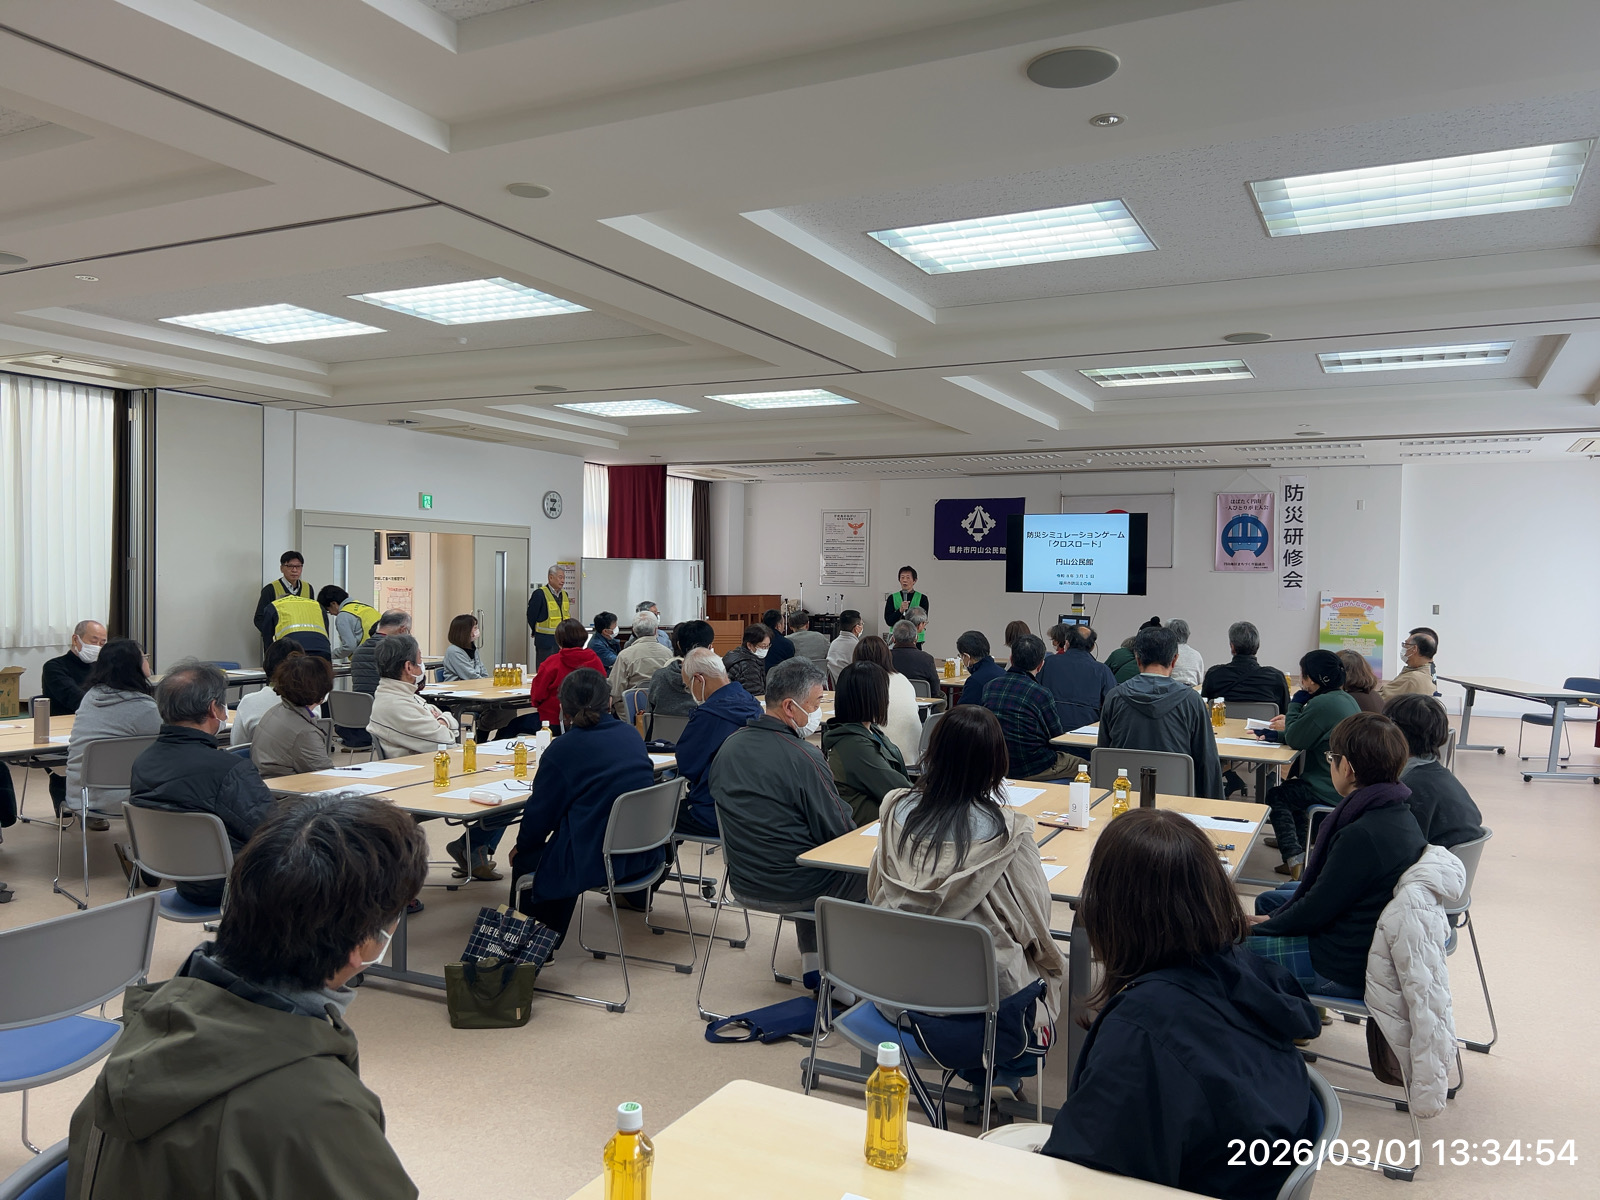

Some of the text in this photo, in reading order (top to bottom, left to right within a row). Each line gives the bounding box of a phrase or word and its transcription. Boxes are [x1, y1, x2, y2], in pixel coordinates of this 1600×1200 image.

[1026, 531, 1125, 539] 防災シミュレーションゲーム
[1283, 484, 1304, 588] 防災研修会
[1048, 540, 1102, 548] 「クロスロード」
[949, 546, 1007, 555] 福井市円山公民館
[1055, 558, 1094, 566] 円山公民館
